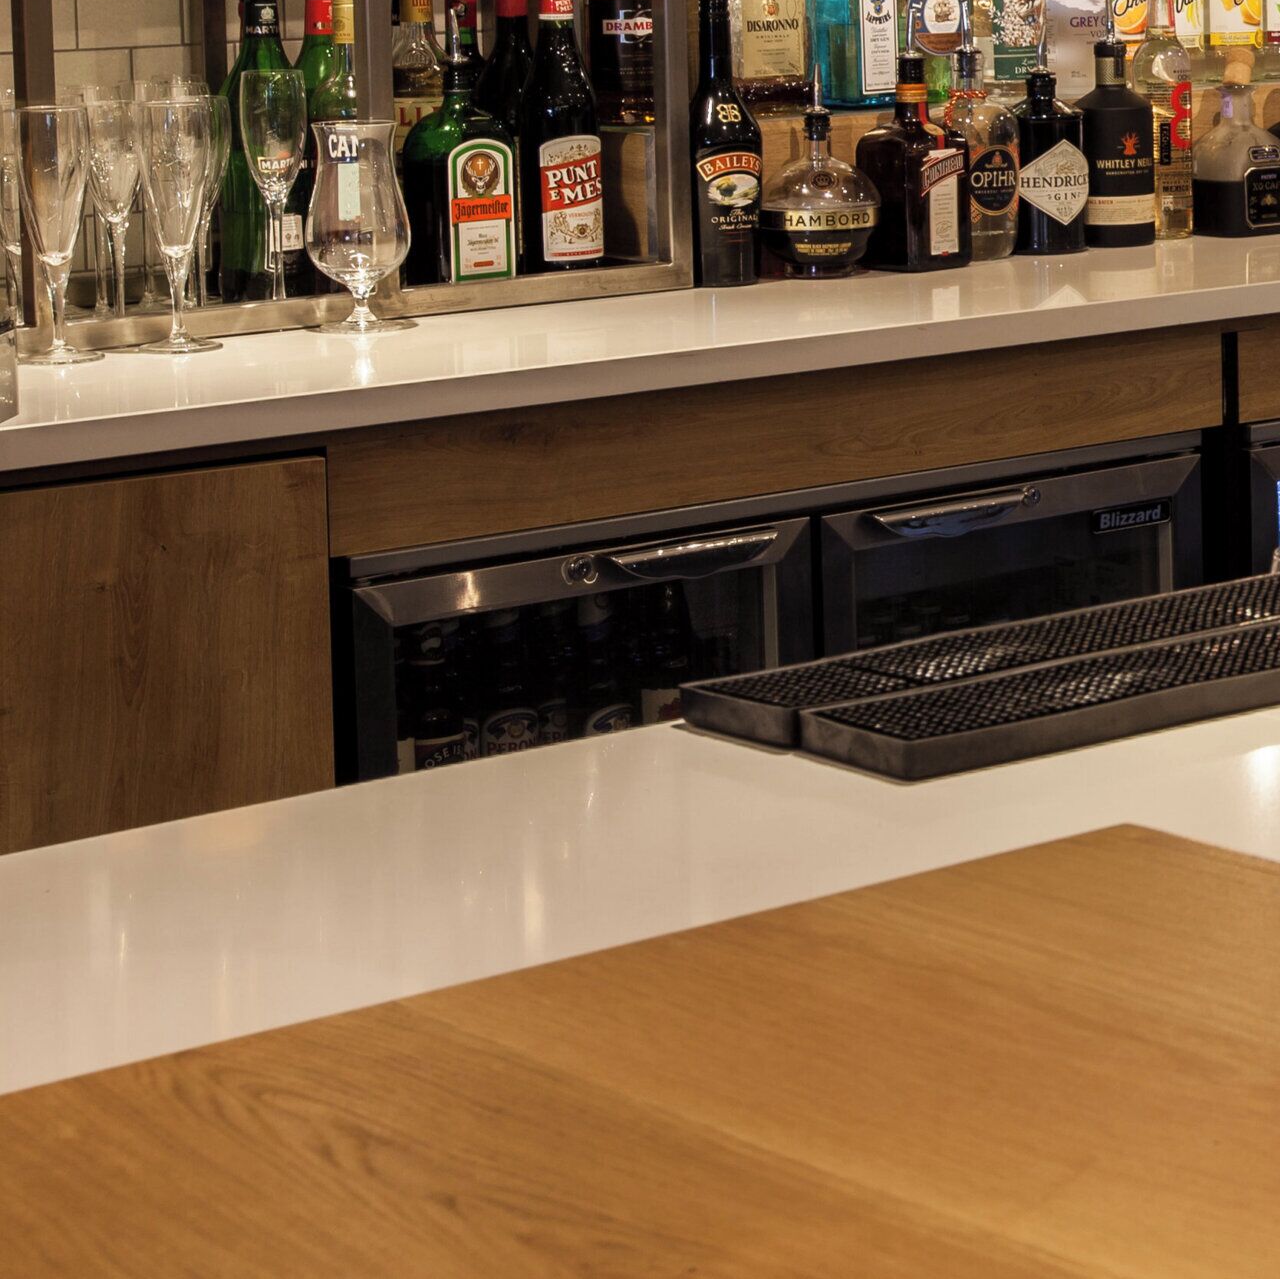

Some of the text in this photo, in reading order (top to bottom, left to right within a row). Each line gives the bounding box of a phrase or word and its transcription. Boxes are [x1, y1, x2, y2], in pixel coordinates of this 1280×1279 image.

[865, 10, 892, 25] SAPPHIRE
[1069, 17, 1098, 28] GREY
[605, 21, 653, 32] DRAMB
[746, 19, 799, 33] DISARONNO
[703, 155, 761, 175] BAILEYS
[1097, 159, 1135, 170] WHITLEY
[545, 160, 597, 188] PUNT
[971, 170, 1016, 188] OPIHR
[550, 177, 602, 205] E MES
[1054, 193, 1077, 201] GIN
[711, 214, 758, 224] ORIGINAL
[729, 208, 745, 217] The
[785, 212, 870, 227] HAMBORD
[1100, 504, 1161, 529] Blizzard
